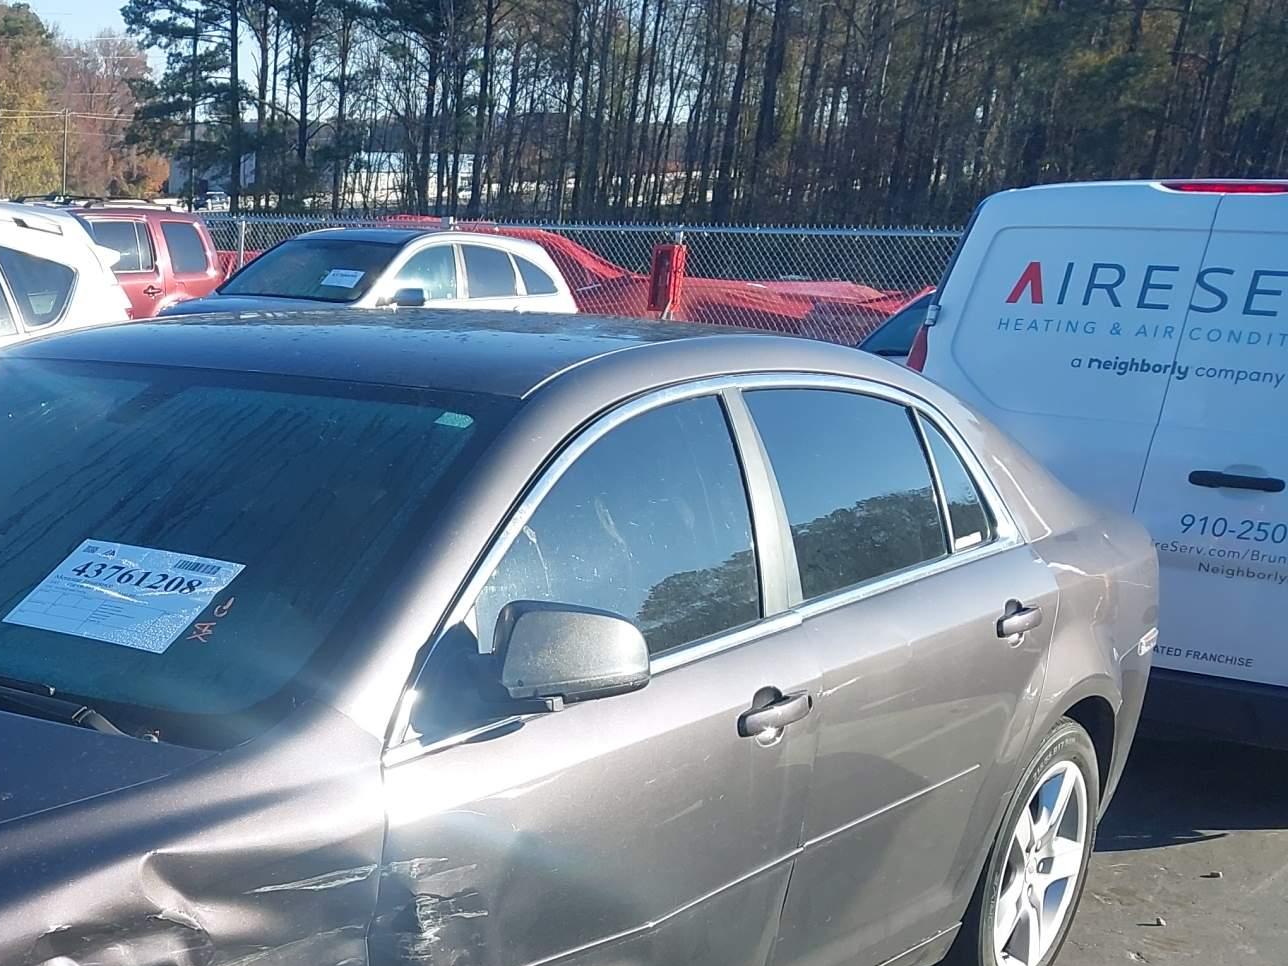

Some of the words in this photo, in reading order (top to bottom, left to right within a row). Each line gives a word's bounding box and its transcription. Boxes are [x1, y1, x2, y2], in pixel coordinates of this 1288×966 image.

[997, 317, 1097, 335] HEATING
[1109, 321, 1123, 336] &
[1135, 323, 1176, 339] AIR
[1071, 357, 1083, 369] a
[1088, 356, 1190, 381] neighborly
[1195, 365, 1286, 388] company
[1152, 538, 1288, 564] reServ.com/Brun
[72, 561, 202, 595] 43761208
[1185, 649, 1254, 668] FRANCHISE
